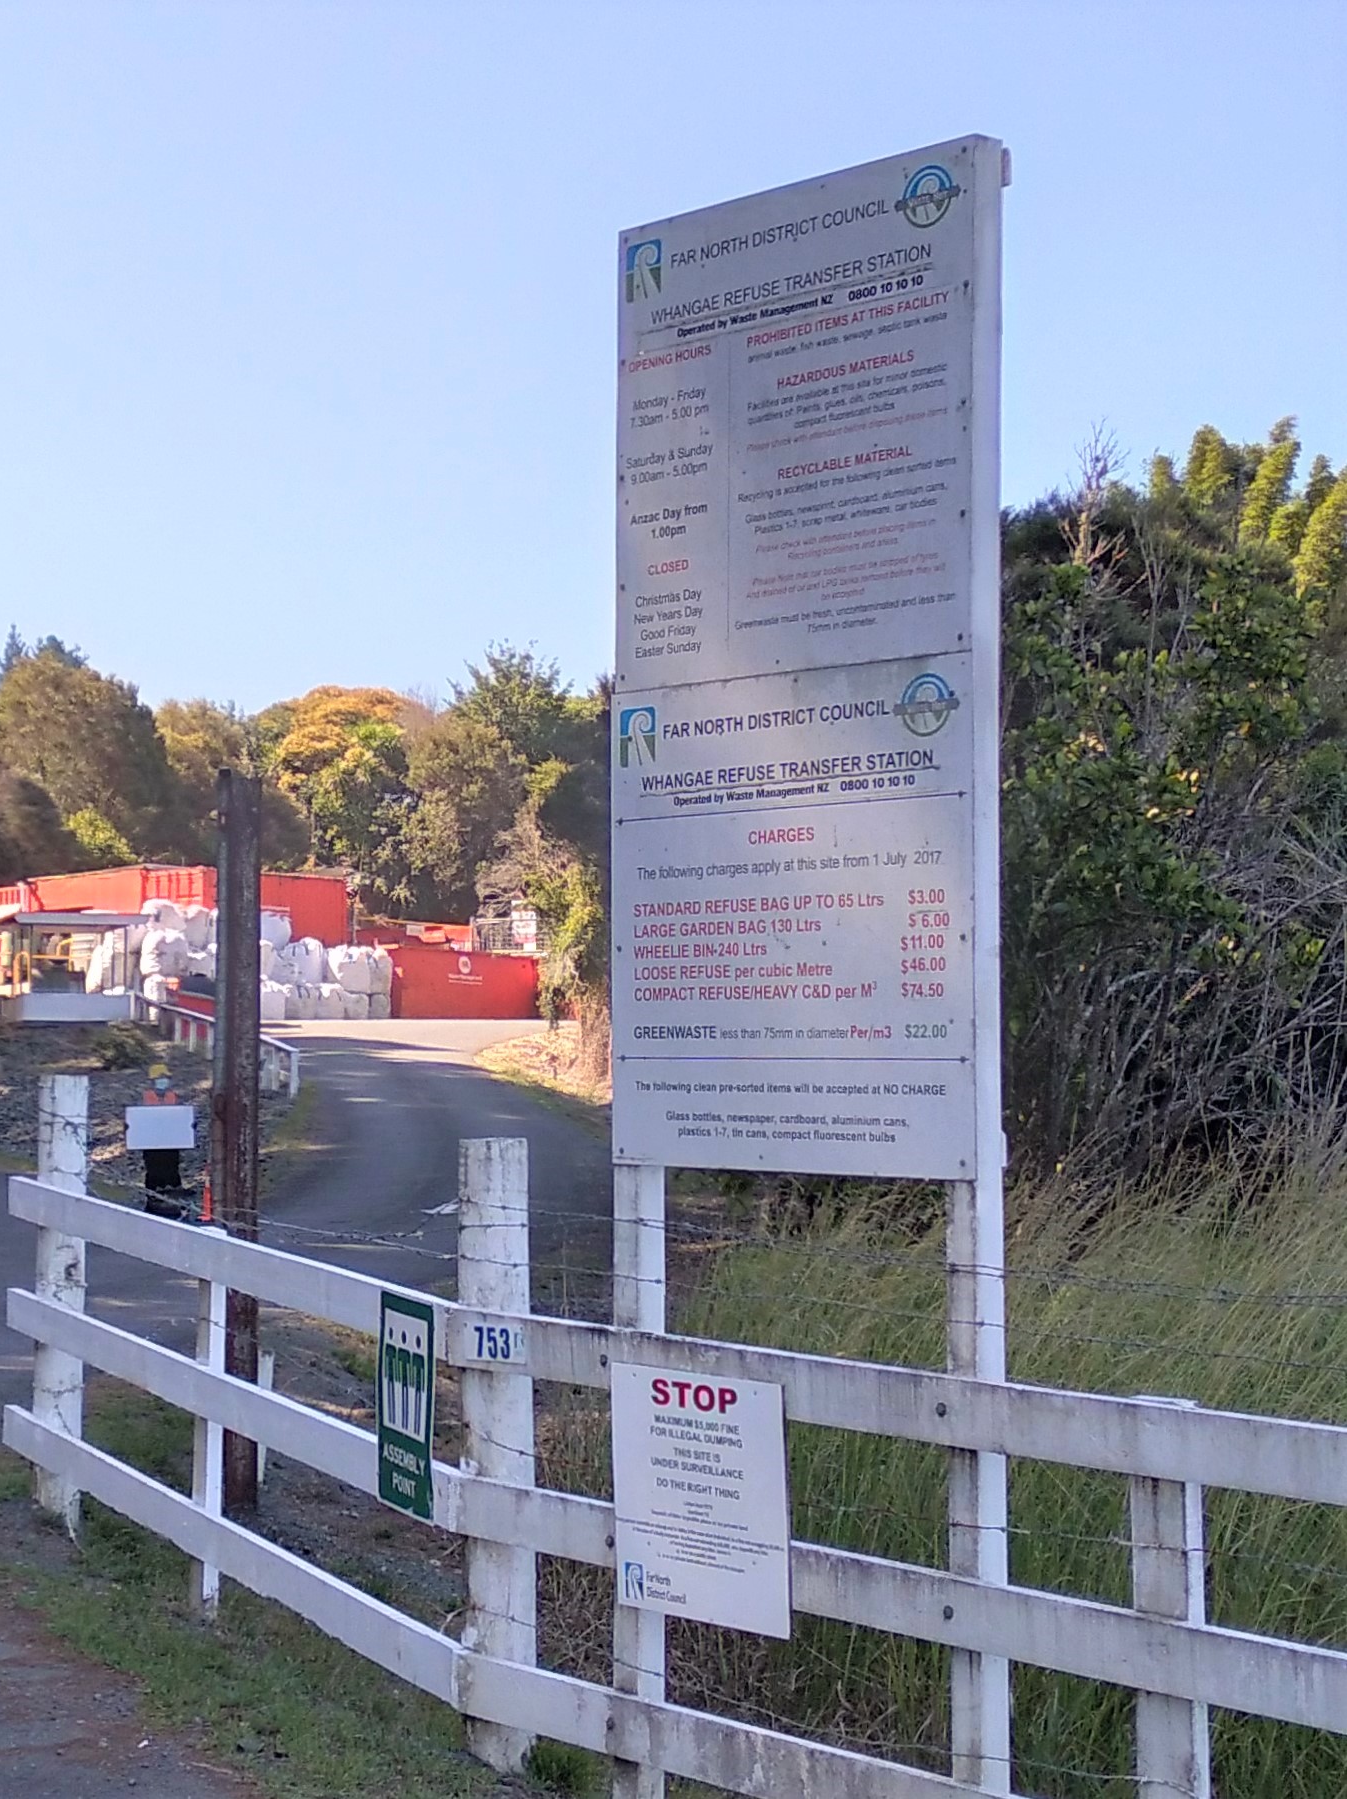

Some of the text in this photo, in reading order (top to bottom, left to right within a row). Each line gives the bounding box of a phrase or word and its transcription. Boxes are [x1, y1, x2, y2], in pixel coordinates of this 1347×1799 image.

[670, 199, 890, 268] FAR NORTH DISTRICT COUNCIL
[650, 243, 931, 324] WHANGAE REFUSE TRANSFER STATION
[746, 290, 949, 348] PROHIBITED ITEMS AT THIS FACILITY
[628, 343, 711, 373] OPENING HOURS
[776, 349, 914, 391] HAZARDOUS MATERIALS
[625, 451, 666, 469] Saturday
[676, 443, 713, 460] Sunday
[777, 445, 912, 480] RECYCLABLE MATERIAL
[629, 503, 708, 525] Anzac Day from
[650, 524, 686, 539] 1.00pm
[646, 558, 689, 576] CLOSED
[634, 588, 702, 608] Christmas Day
[633, 604, 703, 624] New Years Day
[640, 623, 696, 641] Good Friday
[634, 639, 702, 659] Easter Sunday
[662, 721, 690, 739] FAR
[693, 715, 743, 736] NORTH
[747, 707, 815, 730] DISTRICT
[819, 699, 890, 723] COUNCIL
[641, 749, 935, 791] WHANGAE REFUSE TRANSFER STATION
[673, 774, 915, 808] Operated by Waste Management NZ 0800 10 10 10
[747, 826, 814, 845] CHARGES
[636, 849, 942, 880] The following charges apply at this site from 1 July 2017
[633, 888, 945, 918] STANDARD REFUSE BAG UP TO 65 Ltrs $3.00
[633, 922, 676, 938] LARGE
[679, 920, 734, 937] GARDEN
[737, 918, 766, 934] BAG
[770, 918, 792, 933] 130
[796, 918, 821, 932] Ltrs
[633, 943, 689, 959] WHEELIE
[742, 941, 767, 956] Ltrs
[900, 933, 944, 952] $11.00
[634, 955, 946, 981] LOOSE REFUSE per cubic Metre $46.00
[633, 986, 695, 1002] COMPACT
[698, 984, 798, 1000] REFUSE/HEAVY
[801, 983, 831, 999] C&D
[835, 986, 857, 1000] per
[901, 981, 944, 998] $74.50
[633, 1023, 947, 1041] GREENWASTE less than 75mm in diameter Per/m3 $22.00
[635, 1080, 946, 1096] The following clean pre-sorted items will be accepted at NO CHARGE
[665, 1110, 690, 1121] Glass
[830, 1114, 881, 1126] aluminium
[677, 1125, 711, 1138] plastics
[731, 1127, 743, 1137] tin
[771, 1129, 811, 1142] compact
[812, 1128, 866, 1142] fluorescent
[868, 1130, 896, 1143] bulbs
[473, 1326, 511, 1360] 753
[650, 1378, 737, 1414] STOP
[653, 1413, 693, 1428] MAXIMUM
[720, 1423, 739, 1435] FINE
[649, 1425, 743, 1449] FOR ILLEGAL DUMPING
[382, 1442, 426, 1476] ASSEMBLY
[672, 1446, 721, 1463] THIS SITE IS
[650, 1456, 743, 1480] UNDER SURVEILLANCE
[391, 1471, 417, 1498] POINT
[656, 1476, 740, 1500] DO THE RIGHT THING
